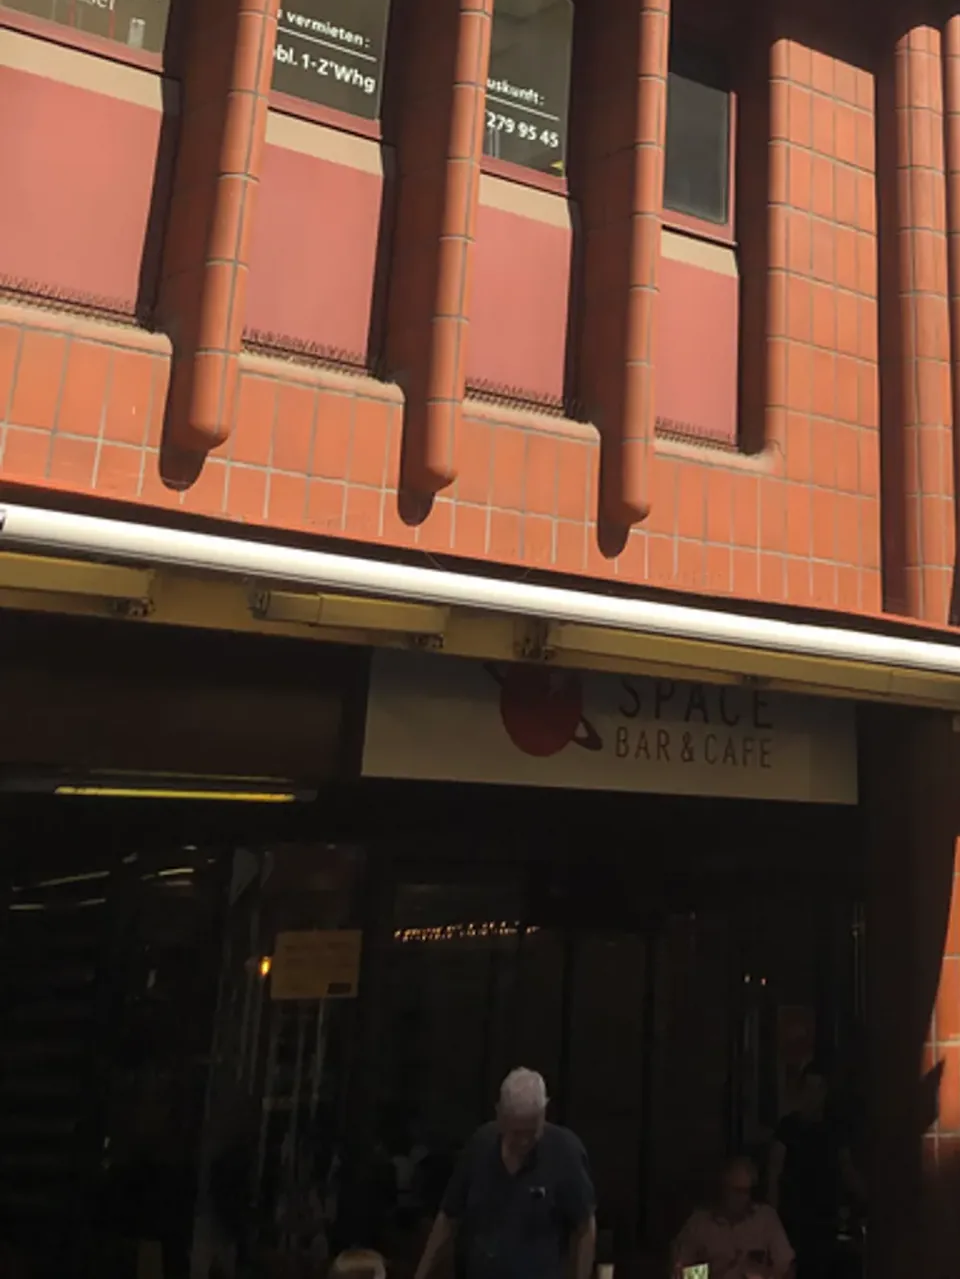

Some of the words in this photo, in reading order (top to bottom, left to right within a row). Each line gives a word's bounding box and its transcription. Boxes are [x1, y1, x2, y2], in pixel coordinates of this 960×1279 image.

[286, 11, 371, 48] vermieten:
[273, 44, 298, 66] bl.
[486, 78, 545, 106] uskunft:
[517, 121, 537, 140] 95
[539, 130, 559, 148] 45
[618, 676, 774, 729] SPACE
